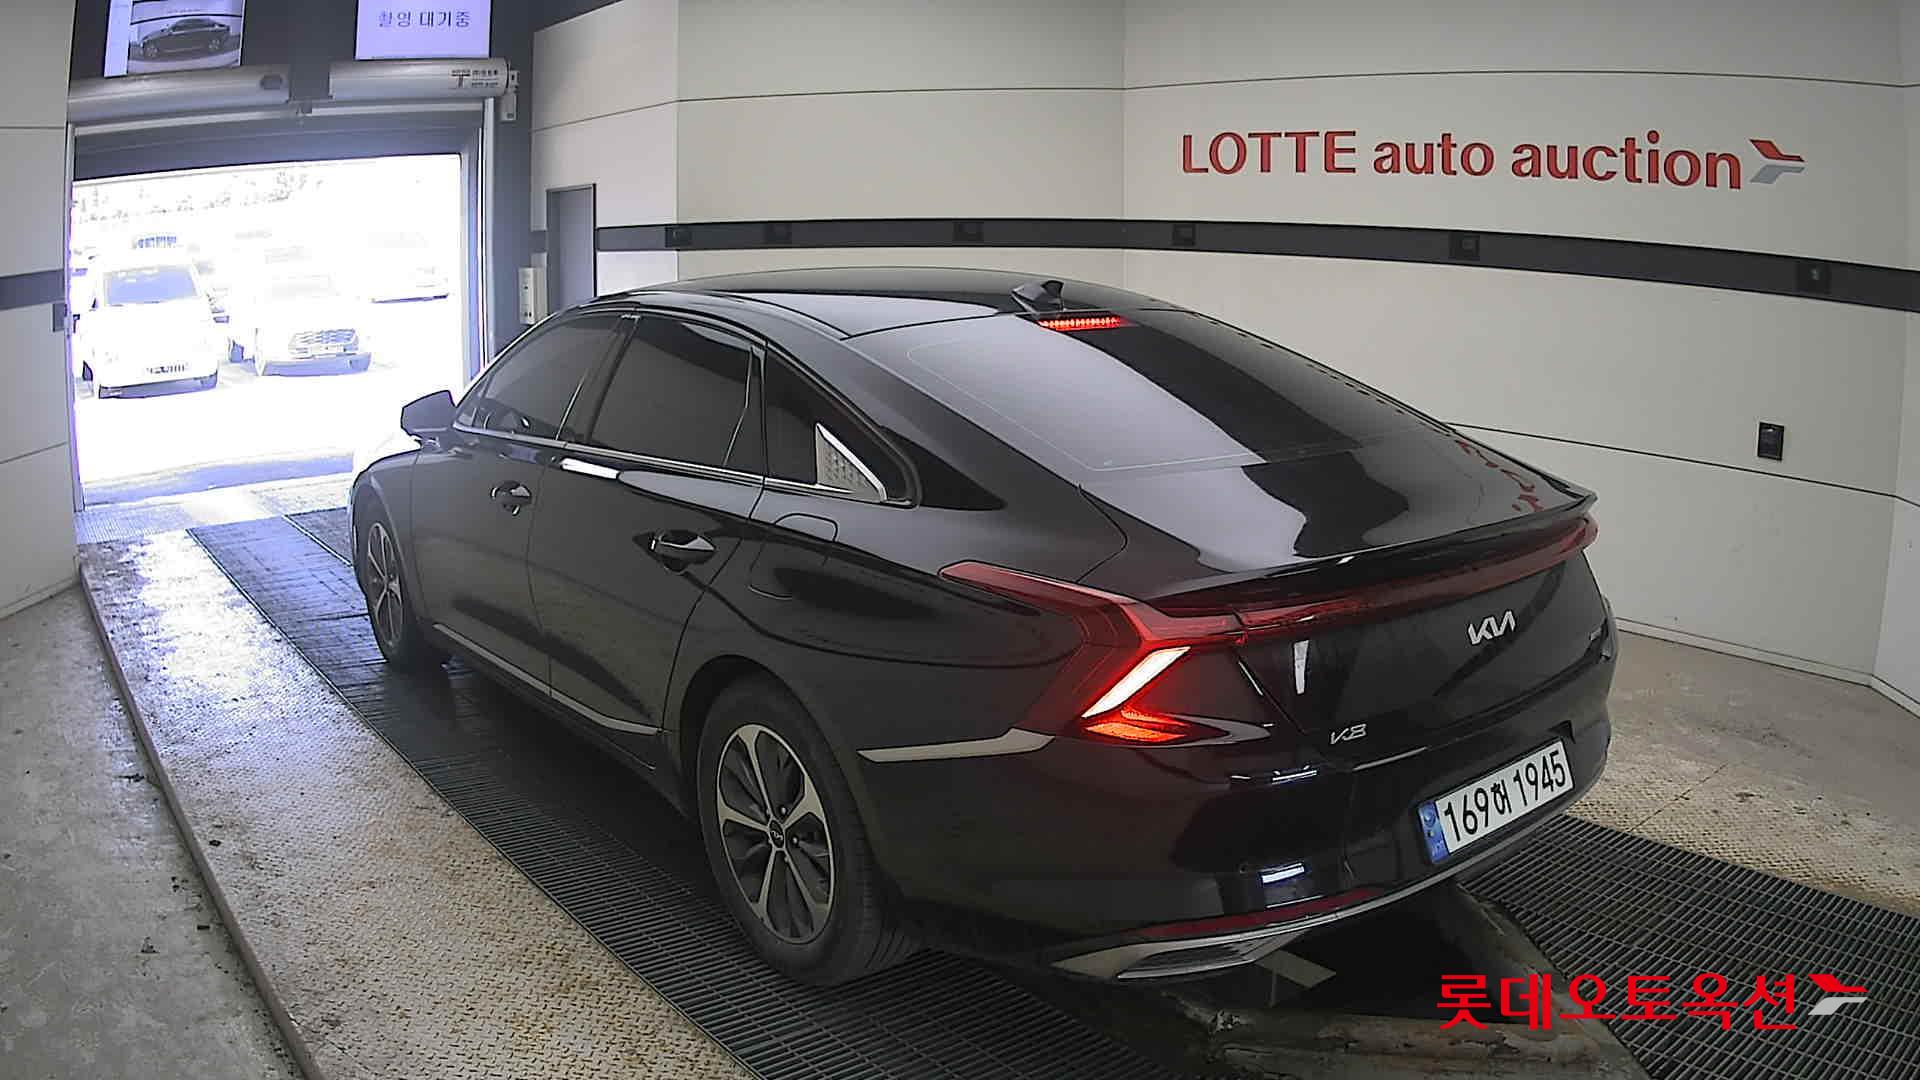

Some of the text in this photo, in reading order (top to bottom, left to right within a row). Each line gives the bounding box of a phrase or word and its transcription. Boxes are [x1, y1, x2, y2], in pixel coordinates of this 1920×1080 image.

[419, 10, 470, 28] 대기중
[1182, 130, 1741, 190] LOTTE auto auction
[1330, 723, 1367, 745] K8
[1444, 750, 1566, 842] 169허 1945
